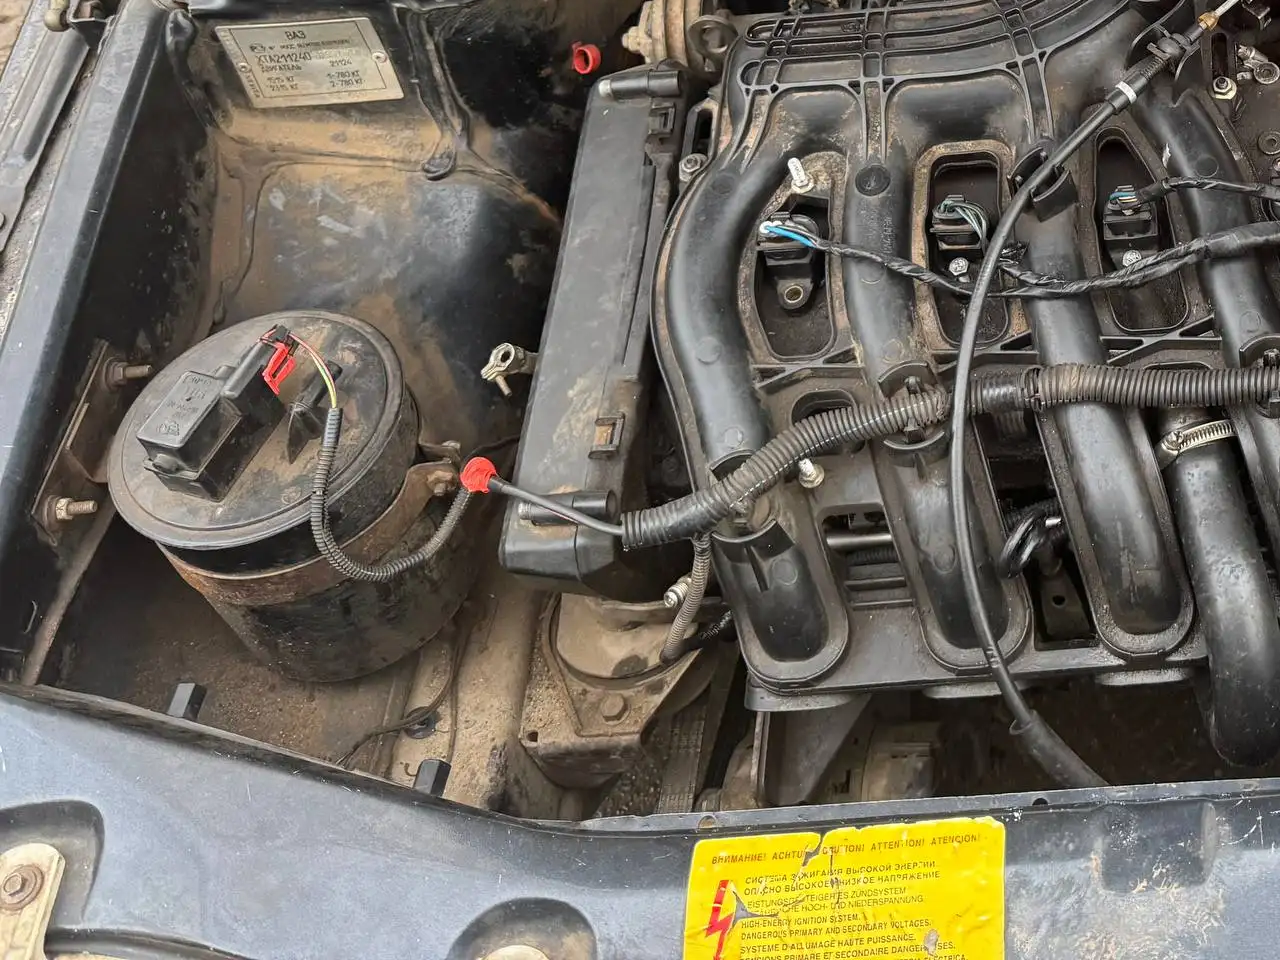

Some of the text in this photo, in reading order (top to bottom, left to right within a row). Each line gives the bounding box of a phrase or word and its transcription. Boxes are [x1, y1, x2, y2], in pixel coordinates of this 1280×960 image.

[285, 30, 306, 40] ВАЗ
[712, 852, 767, 865] ВНИМАНИЕ!
[794, 916, 828, 926] IGNITION
[741, 929, 787, 940] DANGEROUS
[789, 927, 823, 938] PRIMARY
[826, 926, 840, 935] AND
[842, 922, 888, 934] SECONDARY
[740, 943, 780, 954] SYSTEME
[837, 938, 865, 948] HAUTE
